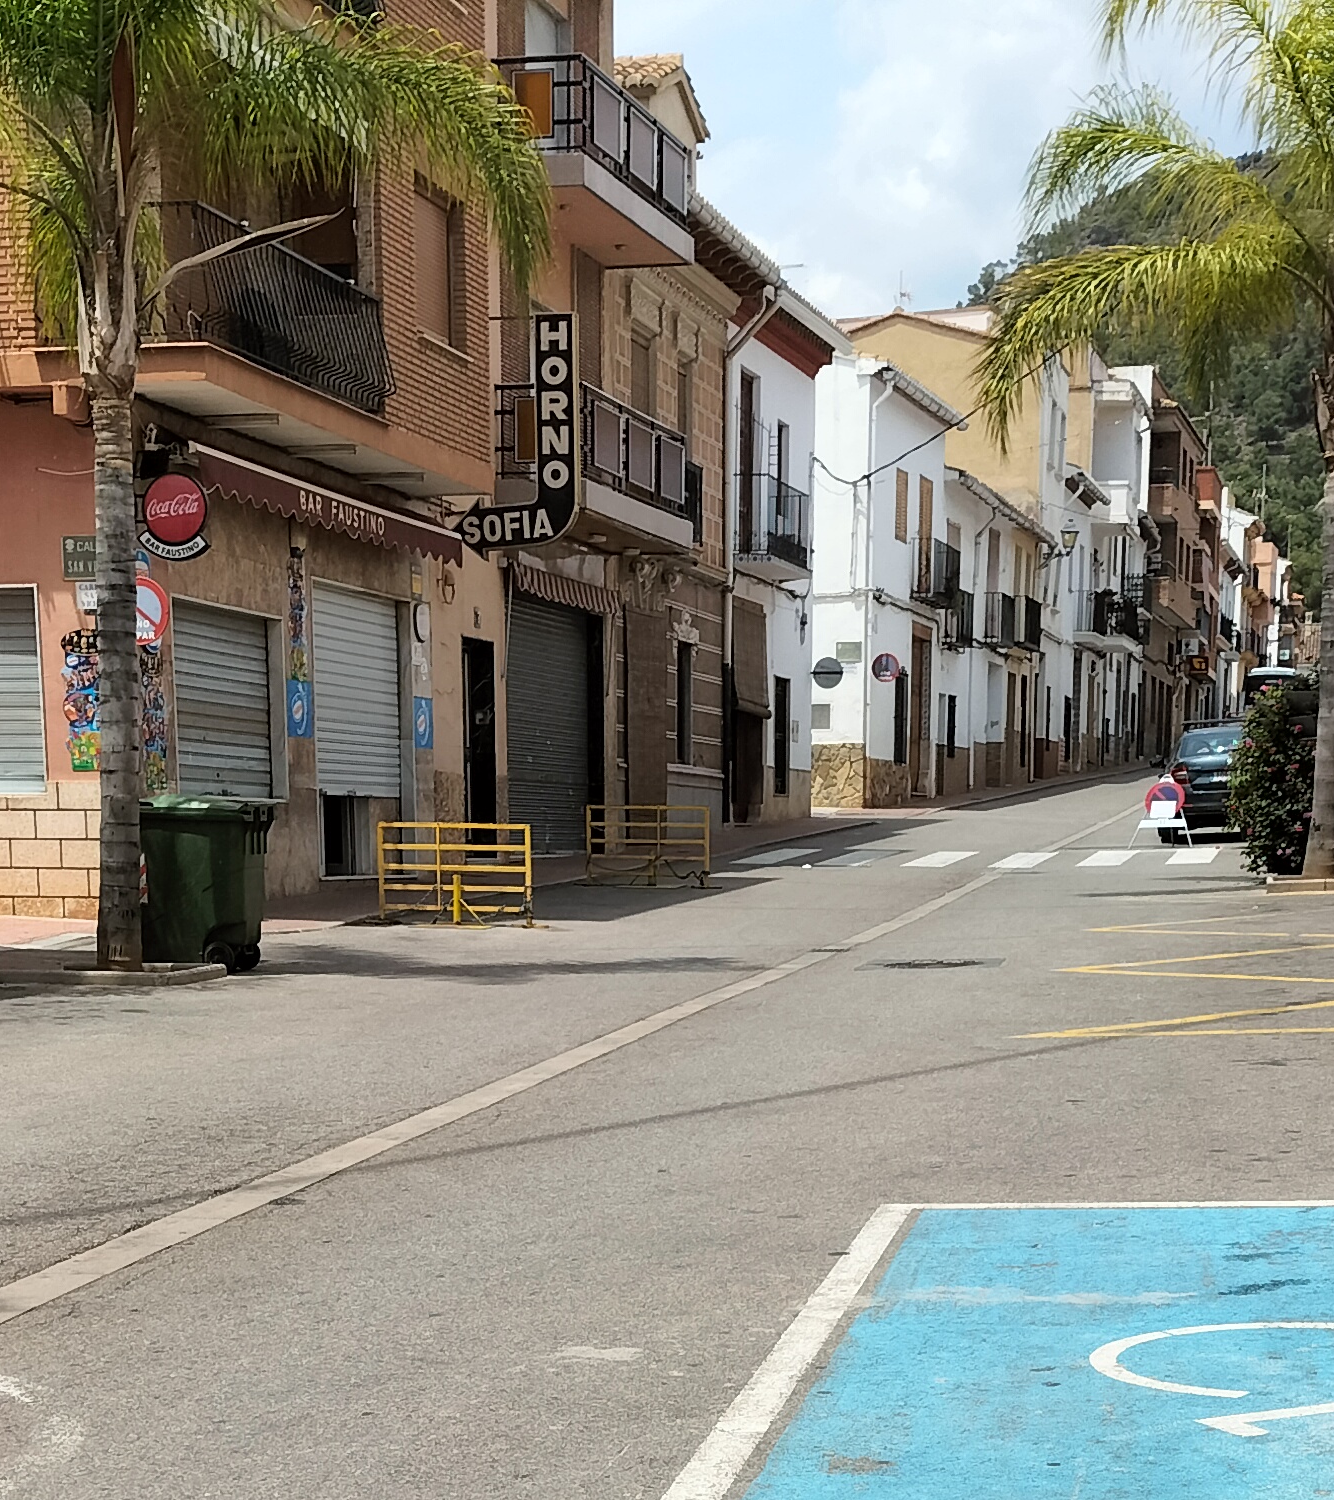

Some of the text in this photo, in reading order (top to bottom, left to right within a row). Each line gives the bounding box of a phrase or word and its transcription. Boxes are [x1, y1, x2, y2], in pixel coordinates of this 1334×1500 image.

[540, 320, 570, 489] HORNO
[300, 490, 385, 536] BAR FAUSTINO
[462, 508, 555, 544] SOFIA
[77, 541, 96, 552] CAL
[145, 537, 199, 557] BAR FAUSTINO
[135, 630, 156, 640] PAR
